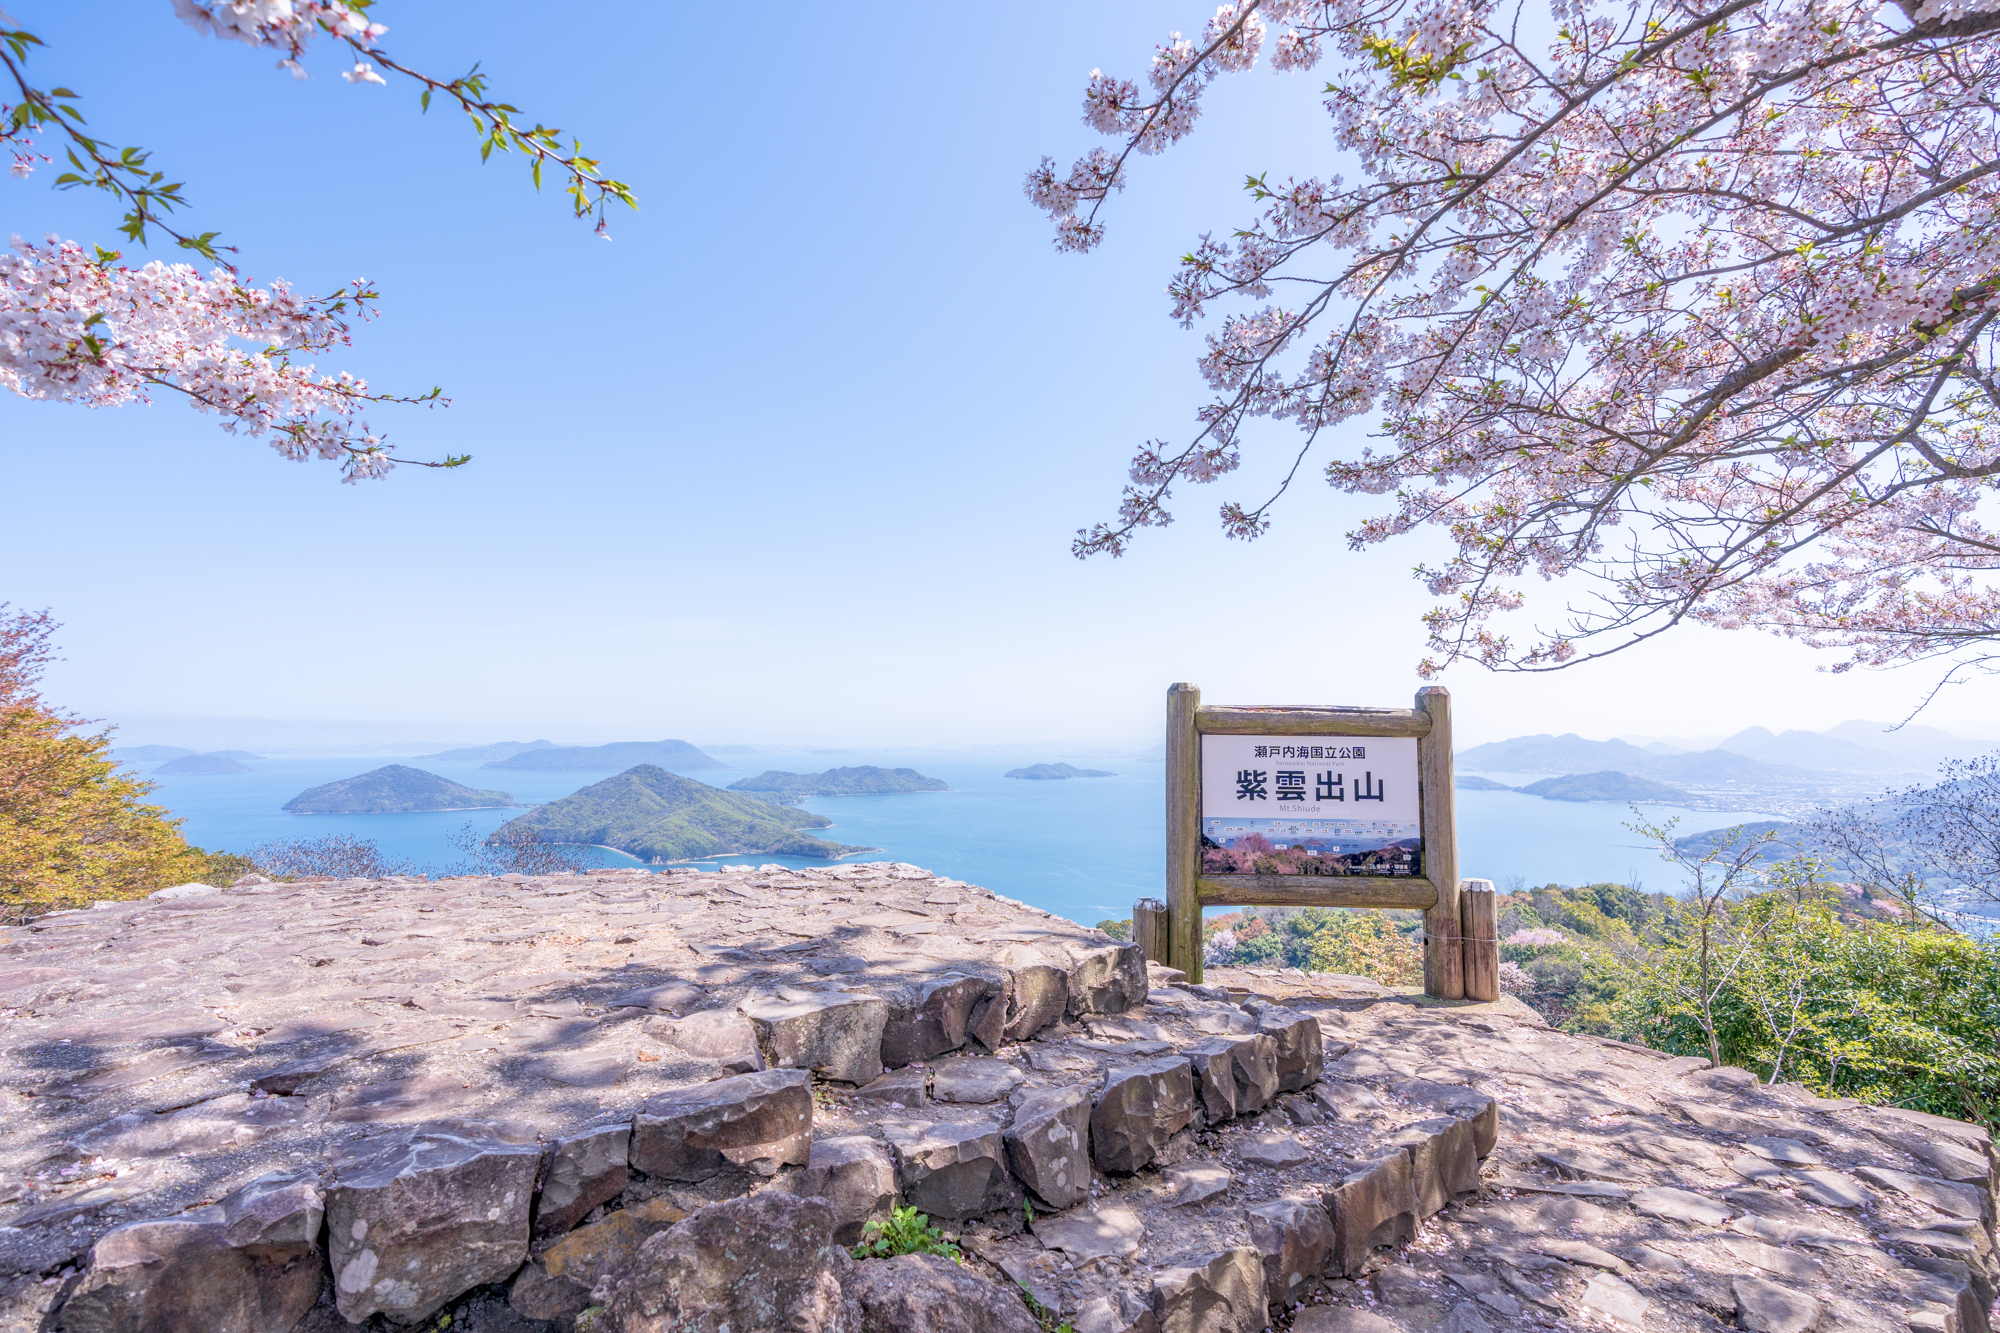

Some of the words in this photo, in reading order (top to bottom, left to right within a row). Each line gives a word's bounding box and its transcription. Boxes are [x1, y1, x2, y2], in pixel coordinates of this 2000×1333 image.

[1254, 745, 1366, 759] 瀬戸内海国立公園
[1236, 769, 1384, 802] 紫雲出山
[1279, 804, 1321, 812] Mt.Shiude
